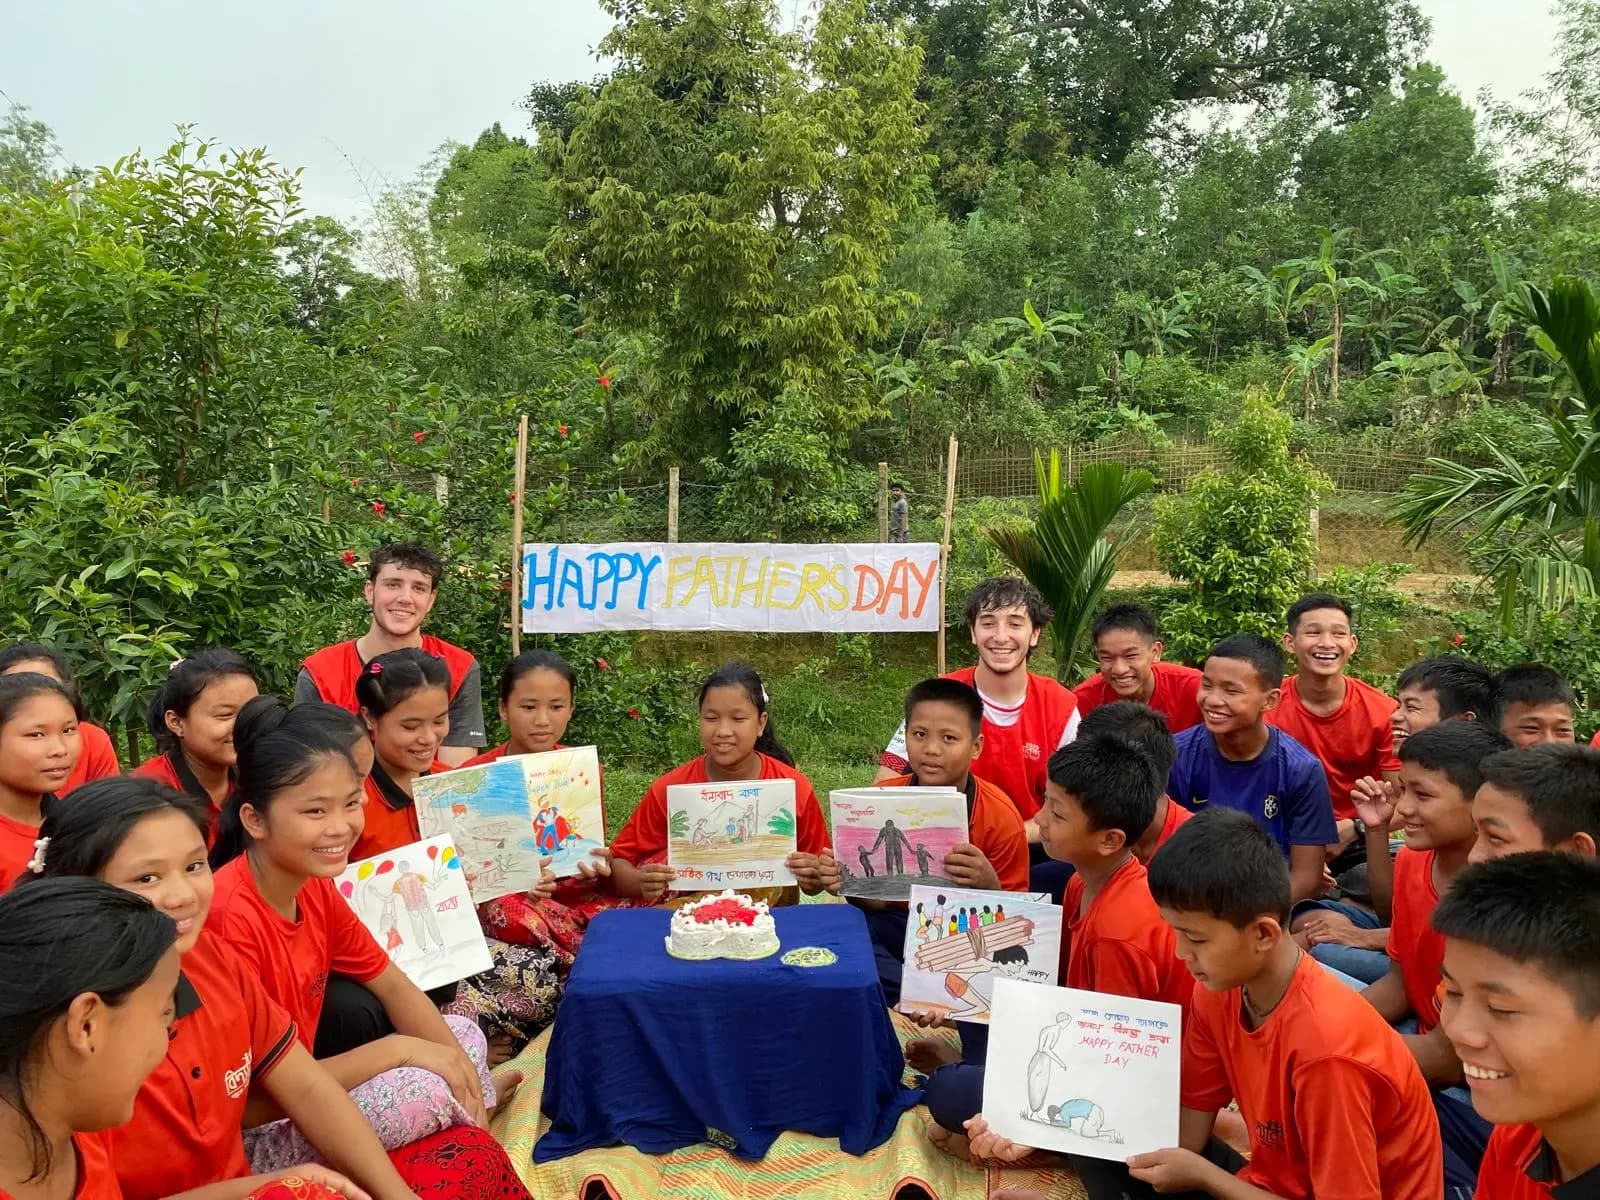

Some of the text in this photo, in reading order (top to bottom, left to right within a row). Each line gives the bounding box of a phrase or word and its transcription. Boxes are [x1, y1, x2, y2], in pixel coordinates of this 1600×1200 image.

[522, 545, 938, 618] HAPPY FATHERS DAY
[1027, 969, 1049, 980] HAPPY
[1079, 1035, 1160, 1058] HAPPY FATHER
[1104, 1054, 1129, 1068] DAY
